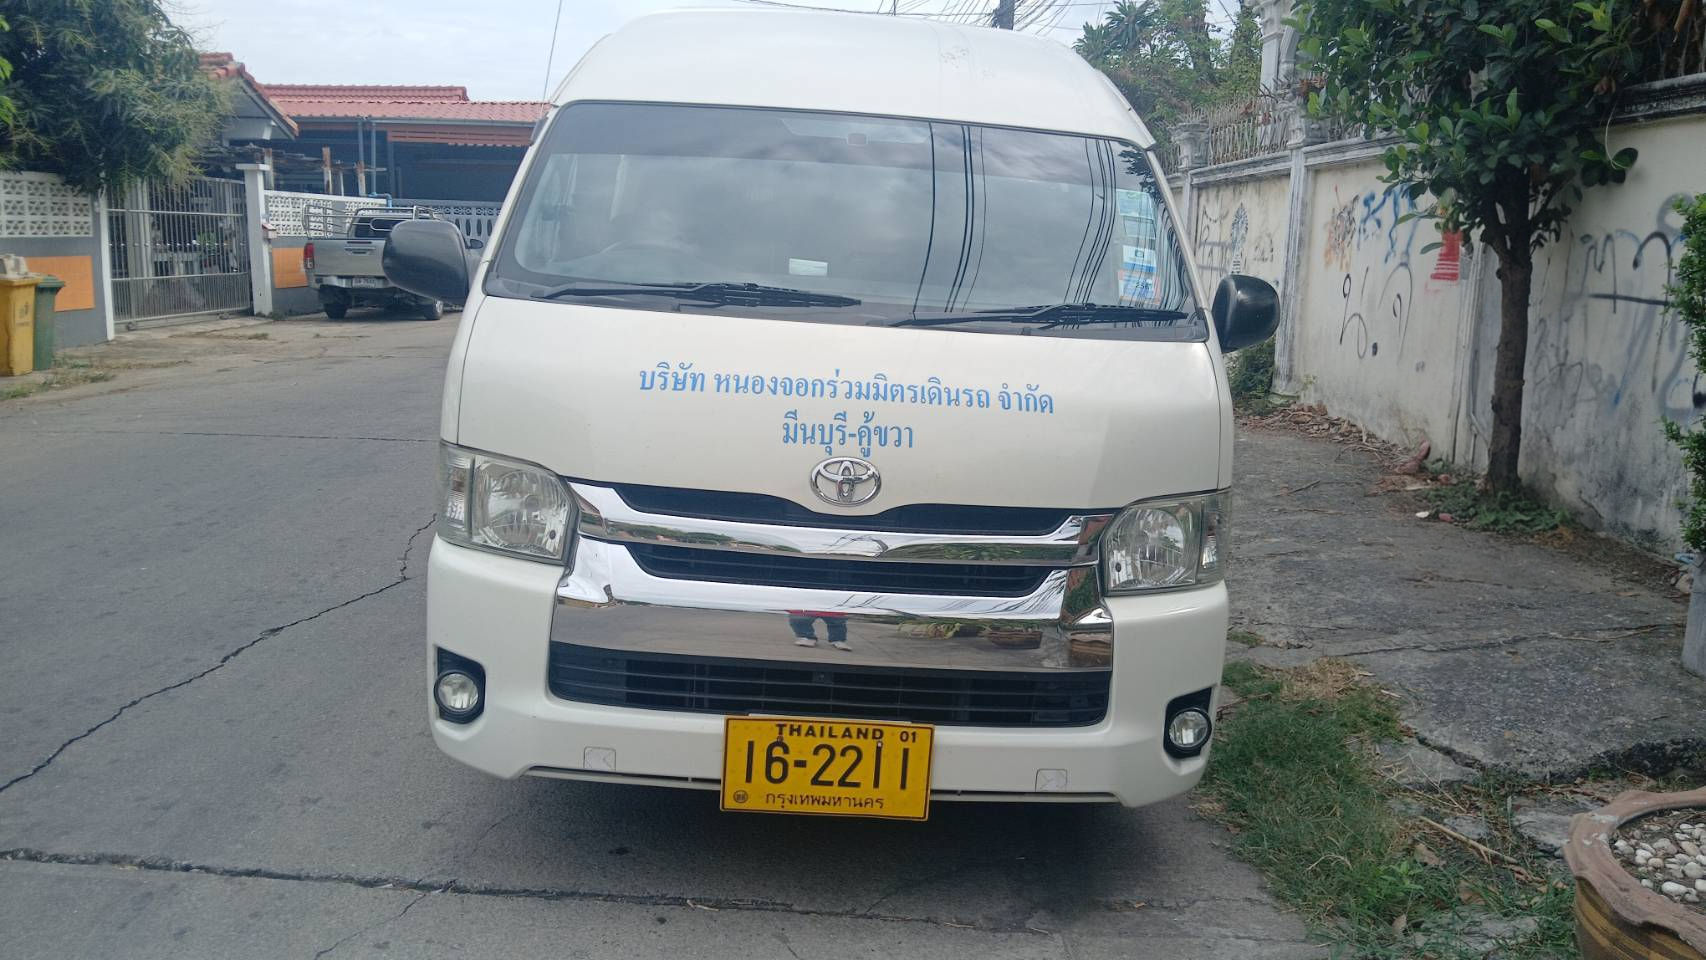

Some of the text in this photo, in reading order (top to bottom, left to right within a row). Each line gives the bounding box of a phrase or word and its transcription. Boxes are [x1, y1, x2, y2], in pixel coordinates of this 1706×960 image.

[639, 361, 1055, 416] บริษัท หนองจอกร่วมมิตรเดินรถ จำกัด
[782, 409, 915, 460] มีนบุรี-คู้ขวา
[775, 723, 917, 743] THAILAND 01
[745, 740, 909, 790] 16-2211
[765, 792, 885, 809] กรุงเทพมหานคร
